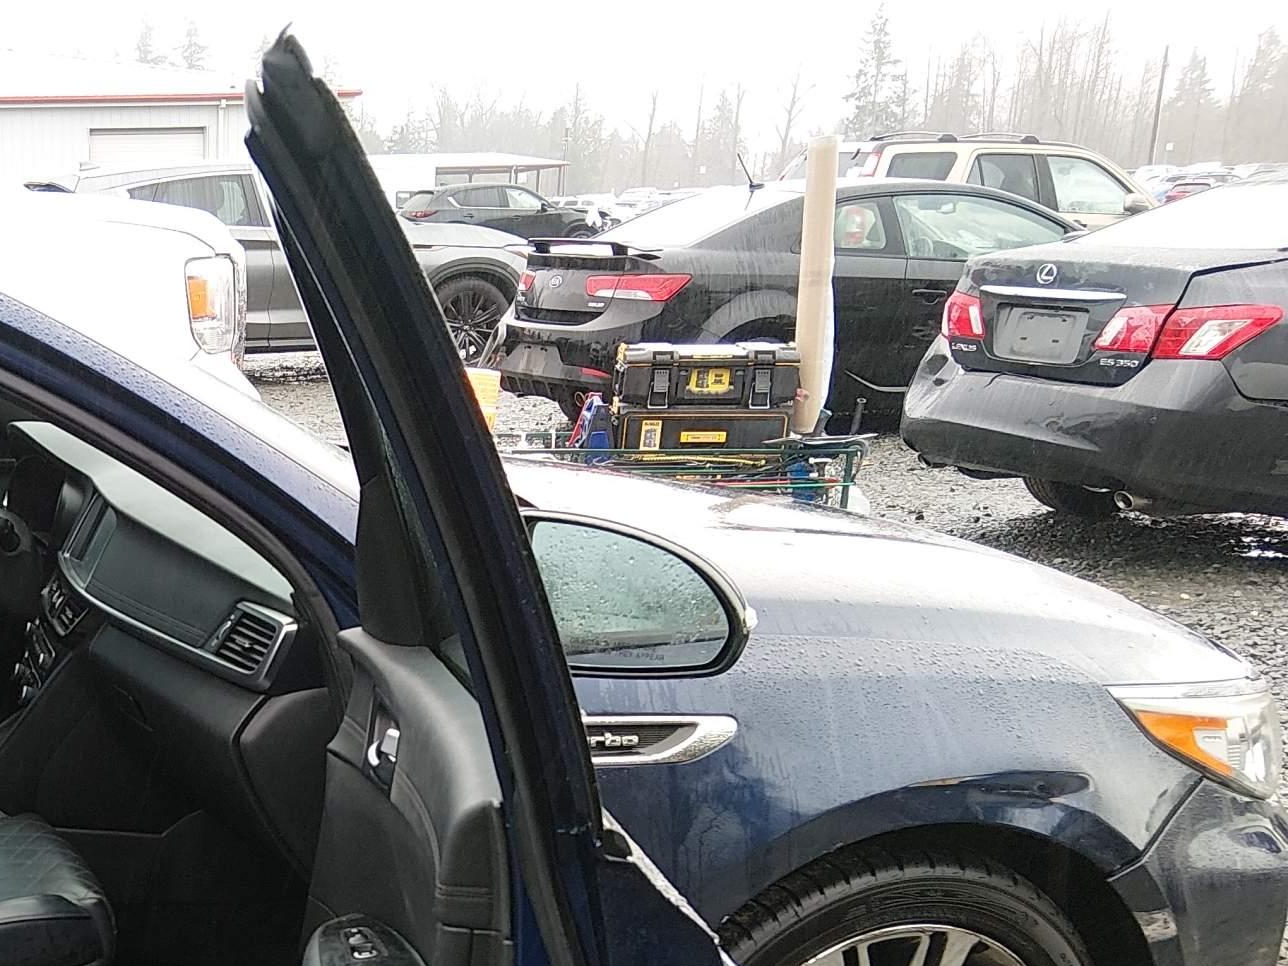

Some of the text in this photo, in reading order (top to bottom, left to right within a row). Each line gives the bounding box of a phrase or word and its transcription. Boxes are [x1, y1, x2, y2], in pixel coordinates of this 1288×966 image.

[1099, 358, 1140, 368] ES 350
[586, 732, 639, 747] rbo
